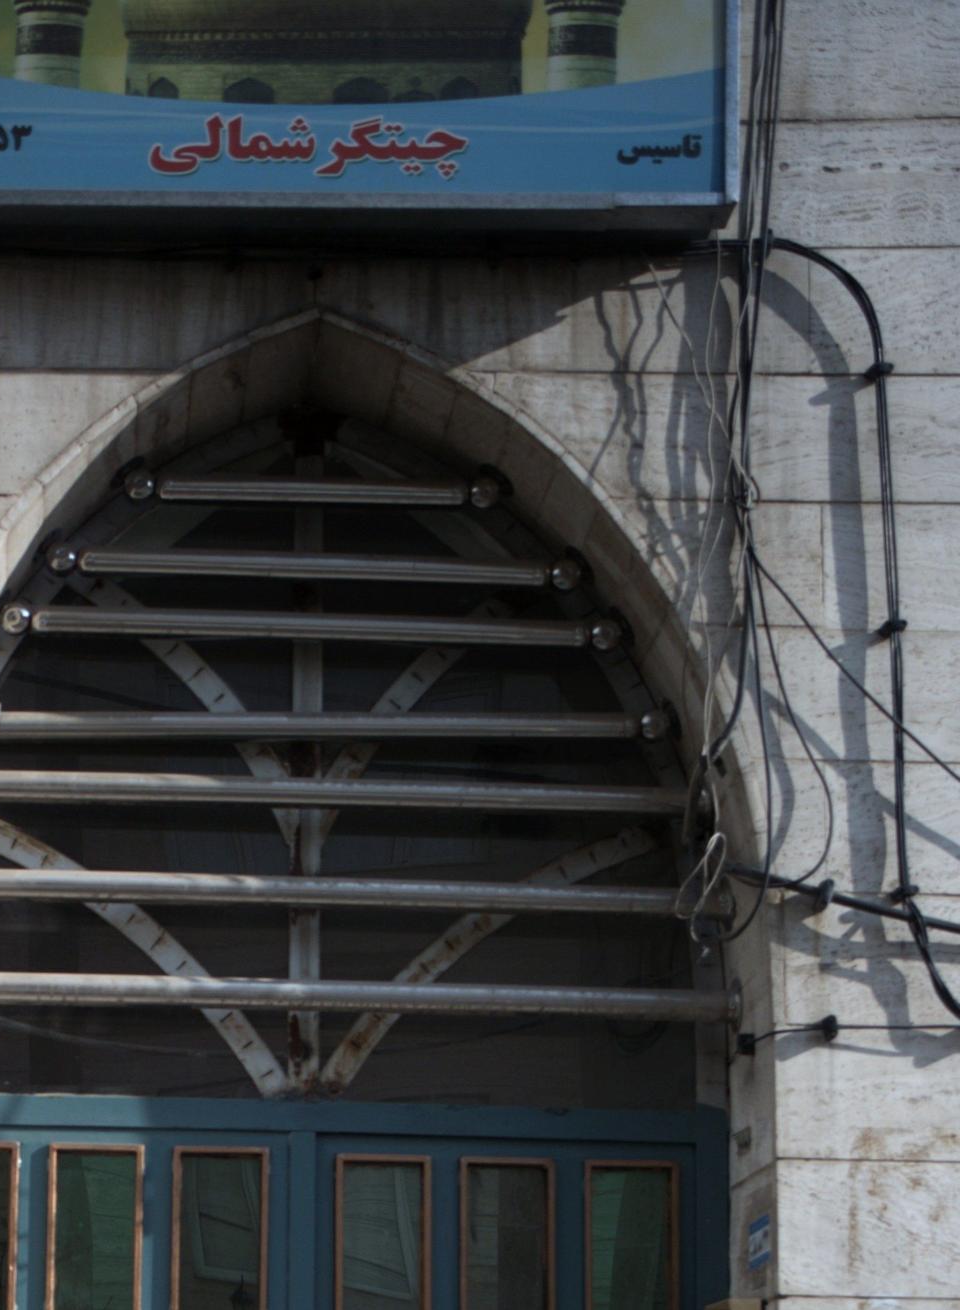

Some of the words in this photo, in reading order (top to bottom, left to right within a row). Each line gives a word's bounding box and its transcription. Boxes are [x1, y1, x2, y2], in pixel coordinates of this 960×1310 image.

[149, 113, 316, 176] شمالی
[315, 115, 469, 179] چیتگر
[616, 133, 702, 166] تاسیس
